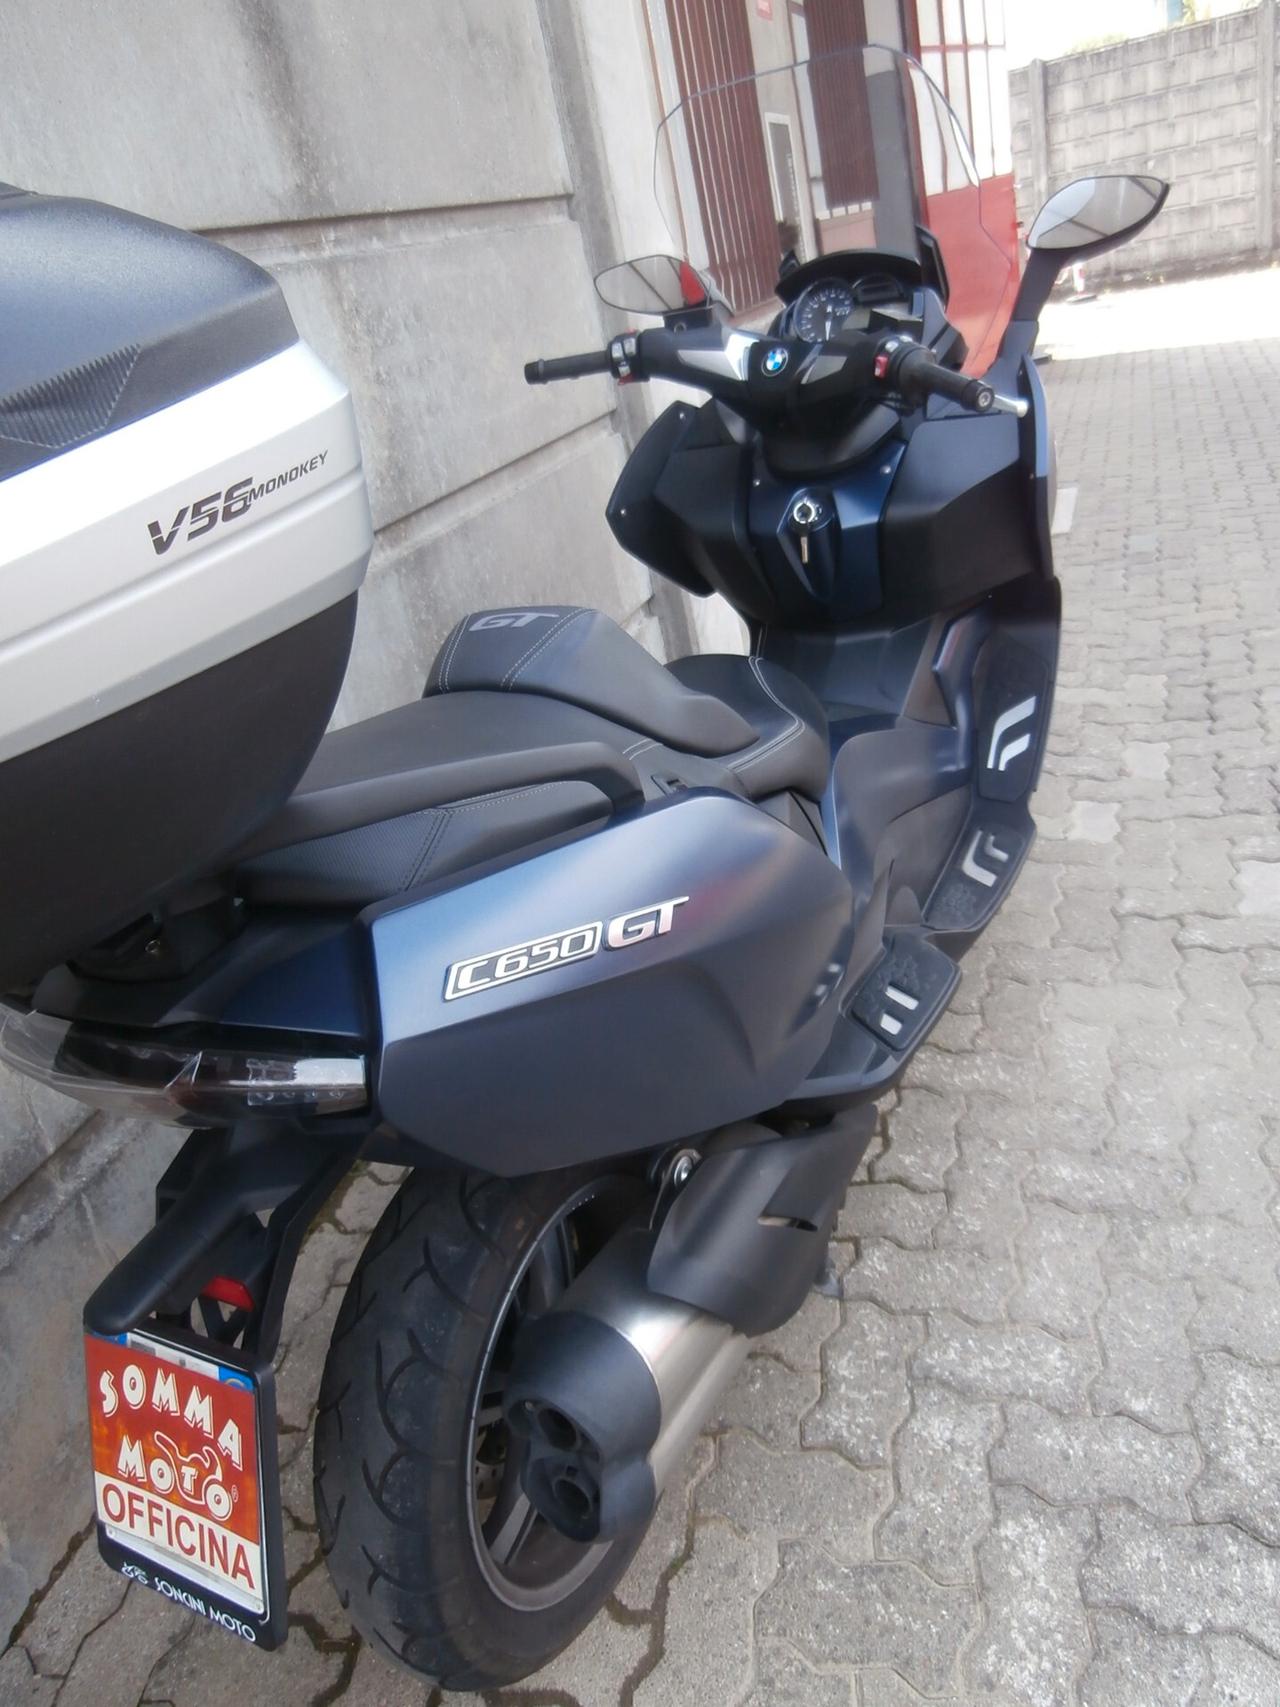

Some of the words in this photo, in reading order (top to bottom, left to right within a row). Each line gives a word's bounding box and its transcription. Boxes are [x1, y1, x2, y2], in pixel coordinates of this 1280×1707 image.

[147, 477, 253, 555] V56
[249, 449, 328, 502] MONOKEY
[469, 612, 560, 632] GT
[606, 896, 690, 949] GT
[99, 1363, 243, 1472] SOMMA
[102, 1483, 256, 1590] OFFICINA
[154, 1576, 207, 1617] SONCINI
[208, 1605, 257, 1643] MOTO
